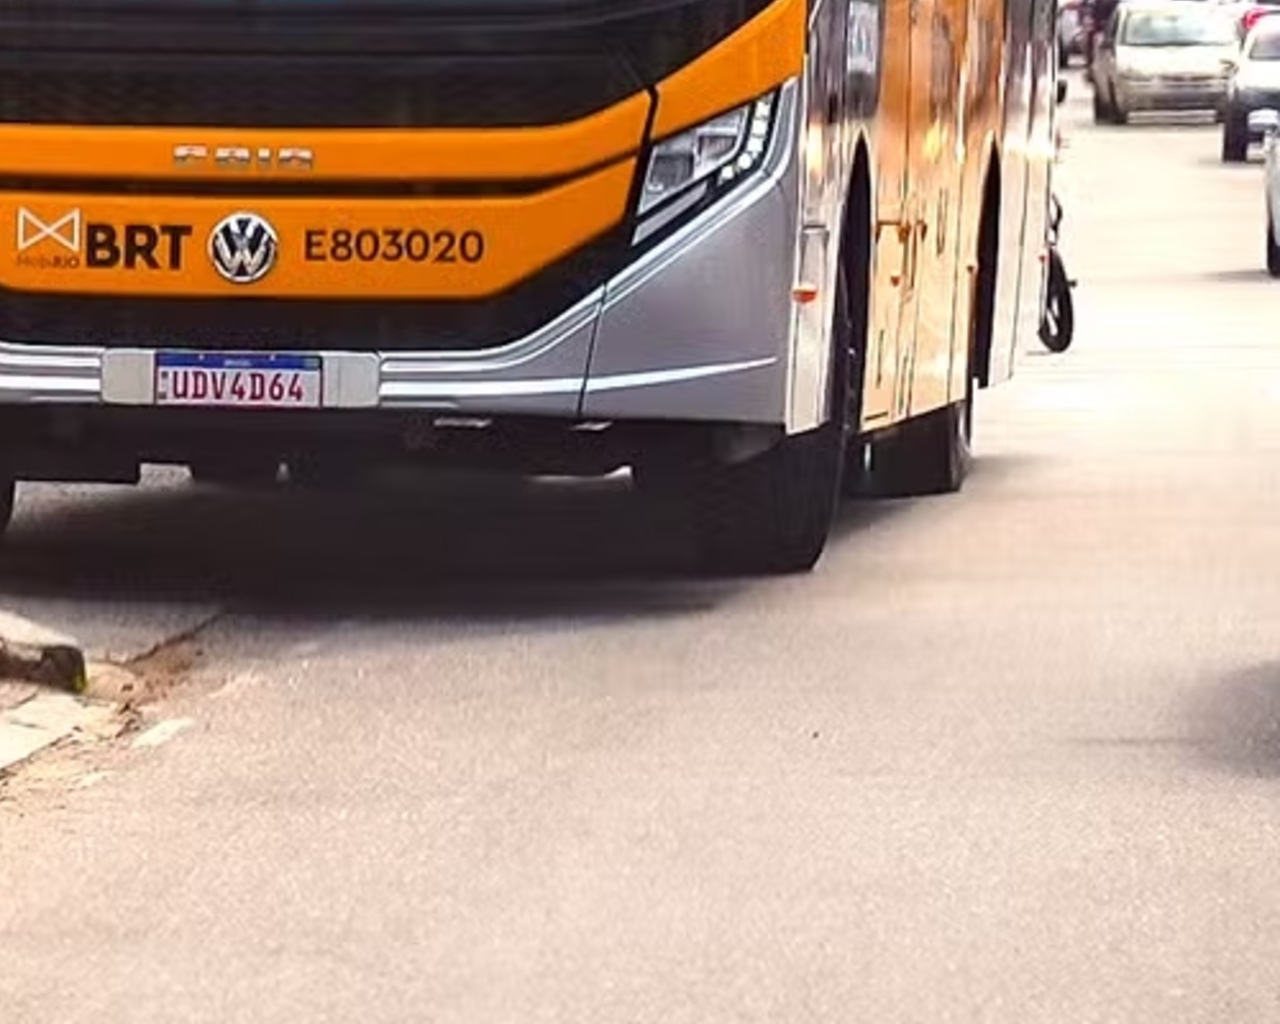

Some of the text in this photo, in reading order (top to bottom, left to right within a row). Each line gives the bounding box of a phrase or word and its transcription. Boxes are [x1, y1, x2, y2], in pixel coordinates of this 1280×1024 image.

[86, 223, 193, 270] BRT
[304, 228, 485, 264] E803020
[172, 370, 303, 401] UDV4D64
